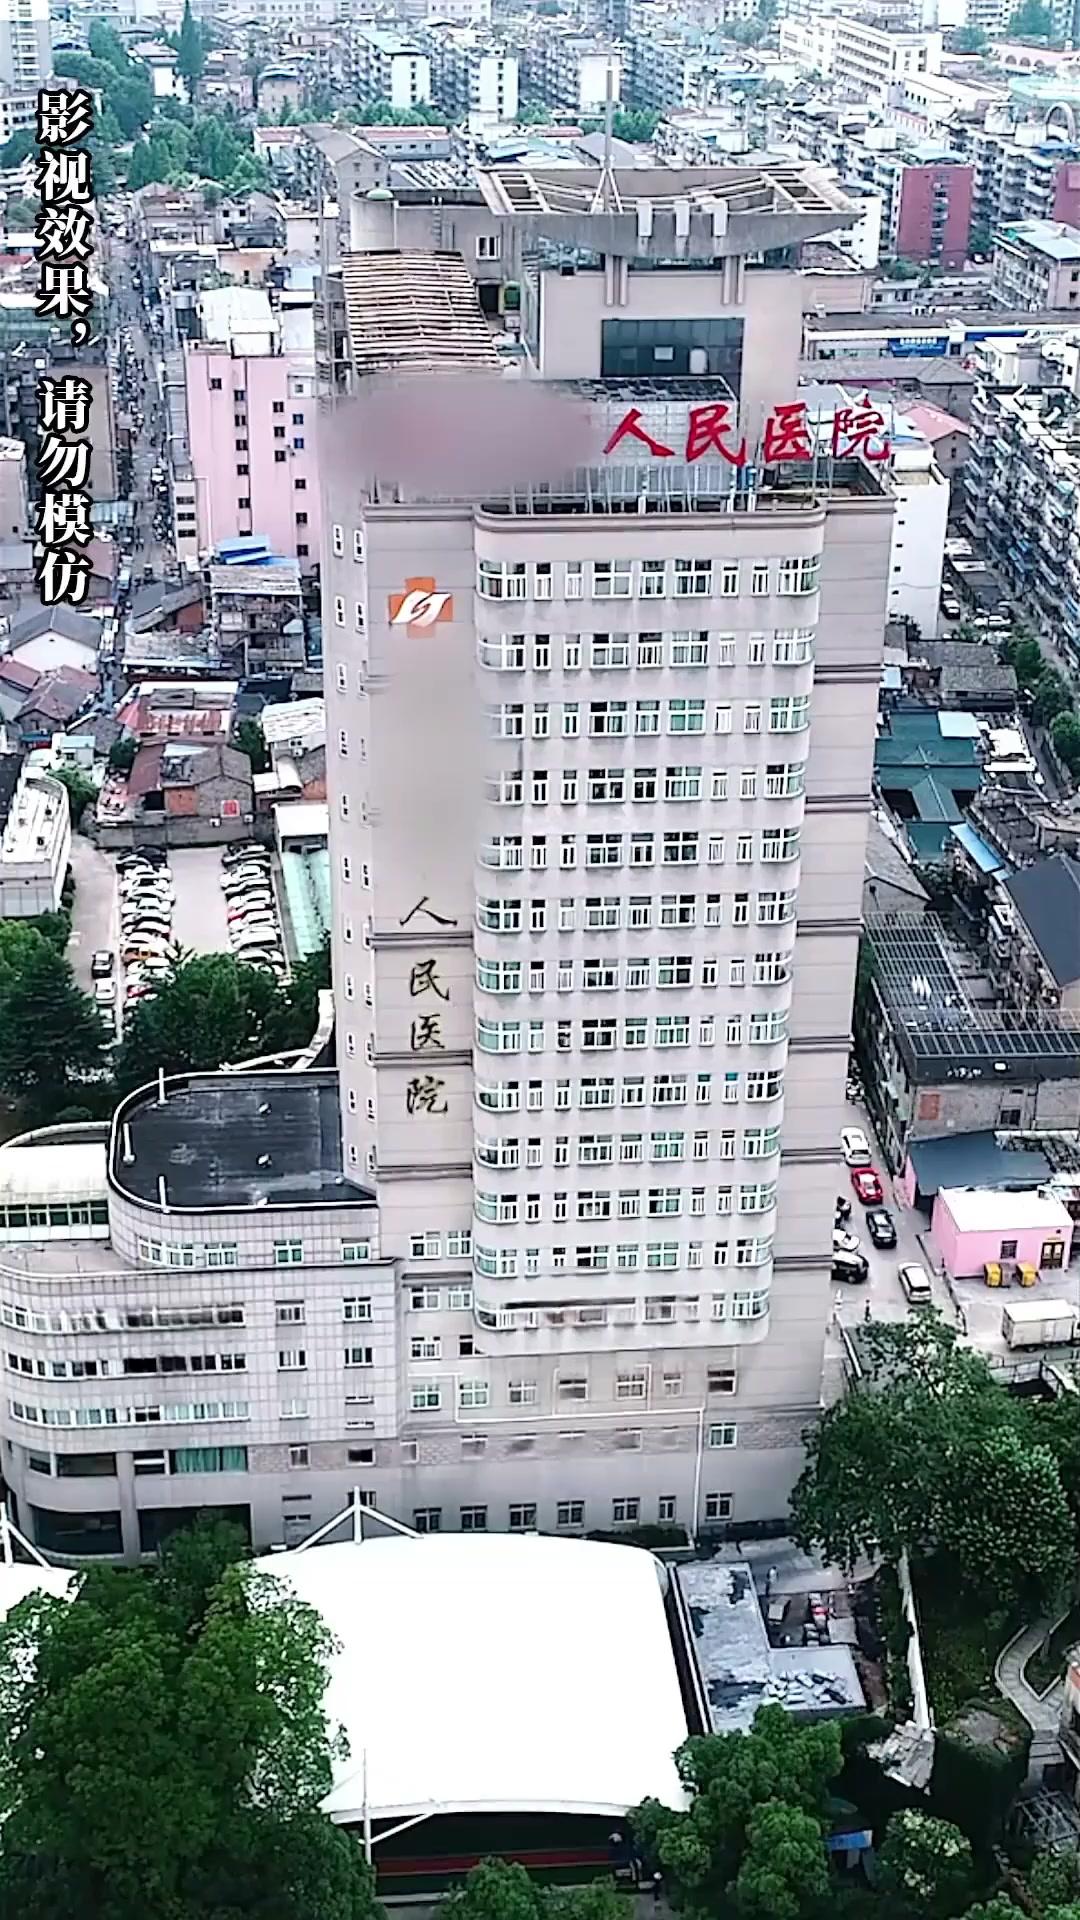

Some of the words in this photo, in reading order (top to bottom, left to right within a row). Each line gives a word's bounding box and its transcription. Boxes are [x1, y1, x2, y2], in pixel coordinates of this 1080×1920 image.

[603, 394, 891, 467] 人民医院
[400, 896, 457, 1114] 人民医院
